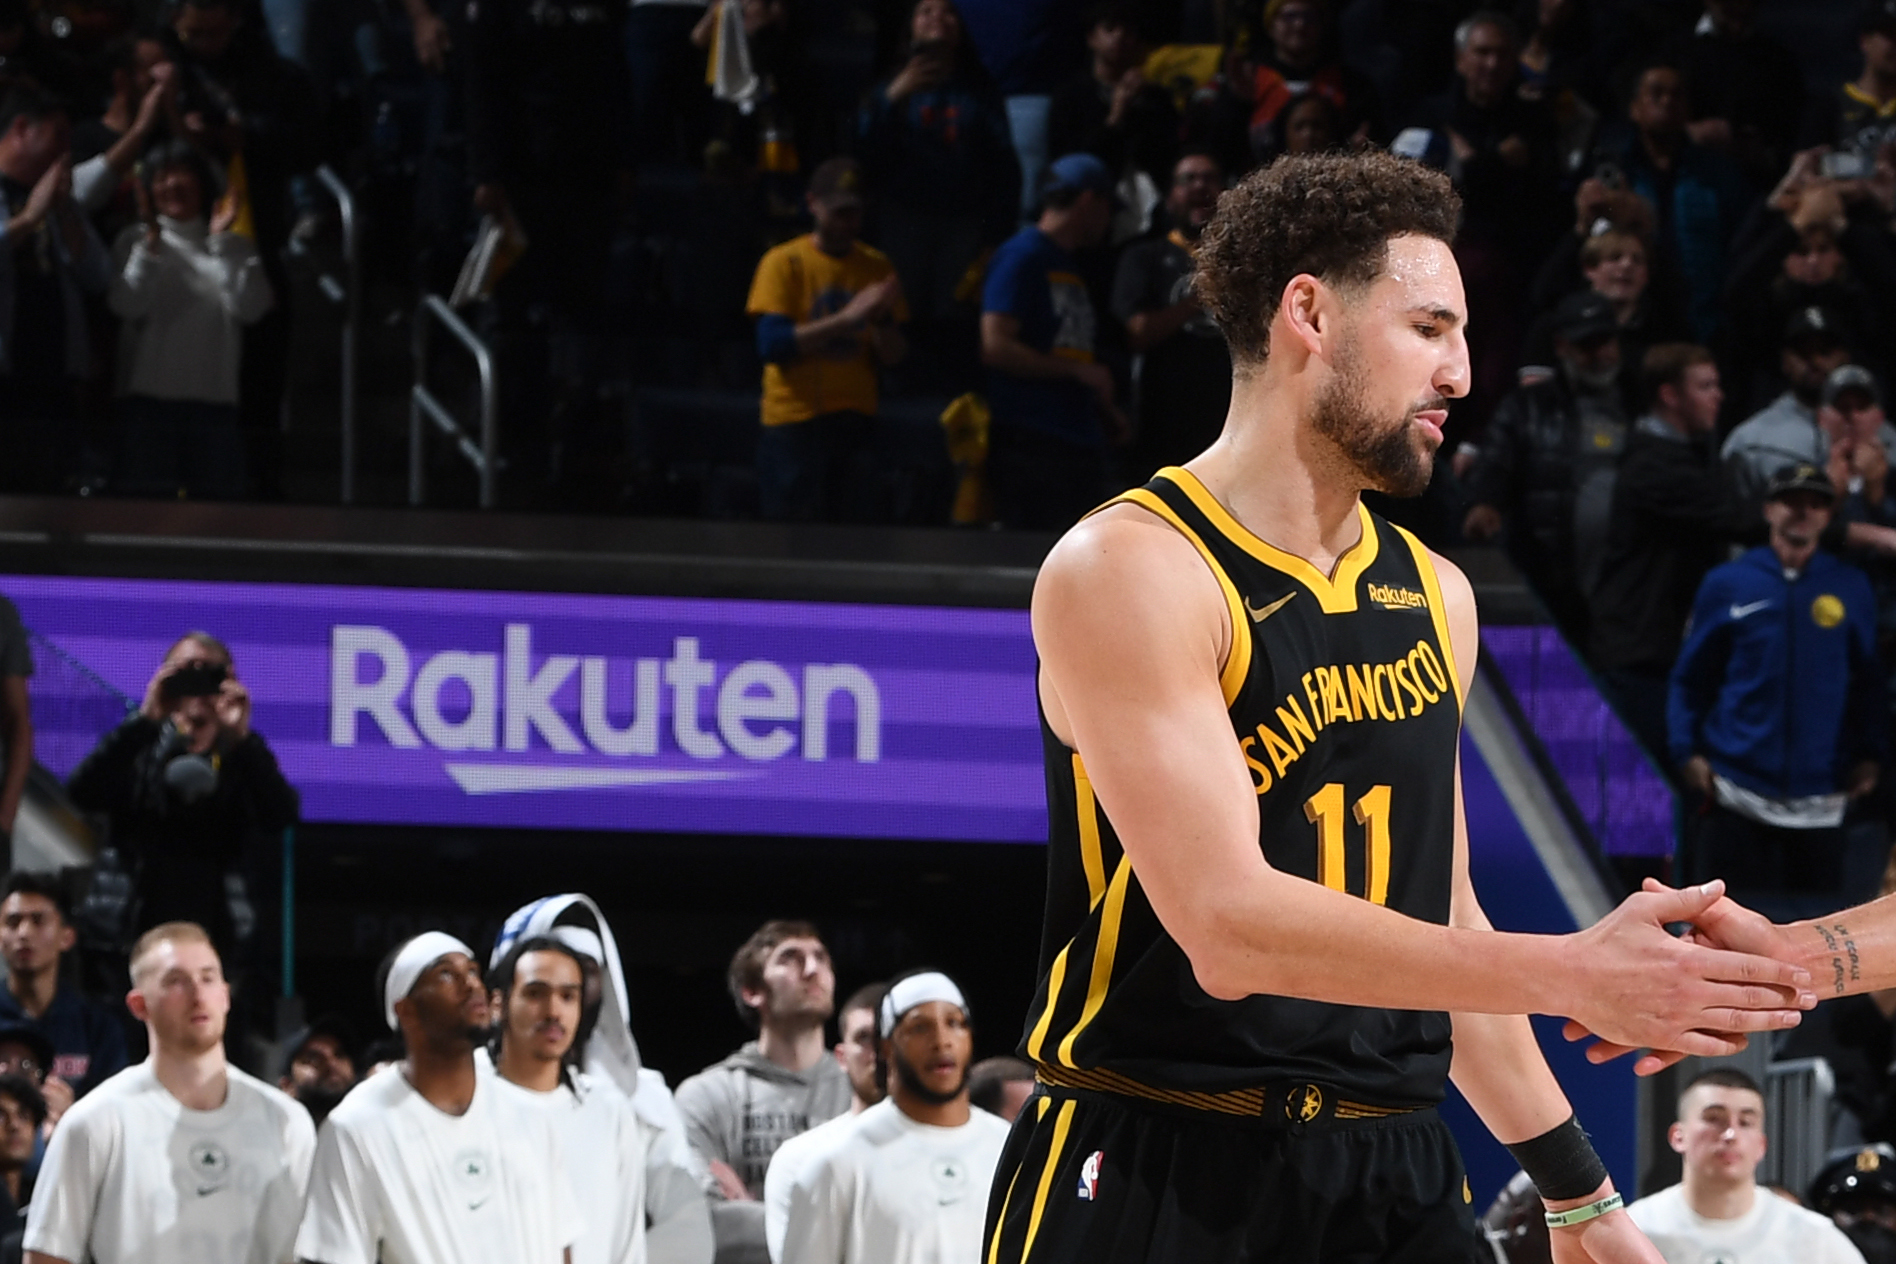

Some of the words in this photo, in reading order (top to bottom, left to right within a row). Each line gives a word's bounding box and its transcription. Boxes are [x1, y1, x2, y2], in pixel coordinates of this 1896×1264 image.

[1367, 582, 1427, 608] Rakuten
[330, 622, 881, 763] Rakuten
[1240, 692, 1317, 796] SAN
[1302, 638, 1448, 732] FRANCISCO
[1302, 781, 1393, 906] 11
